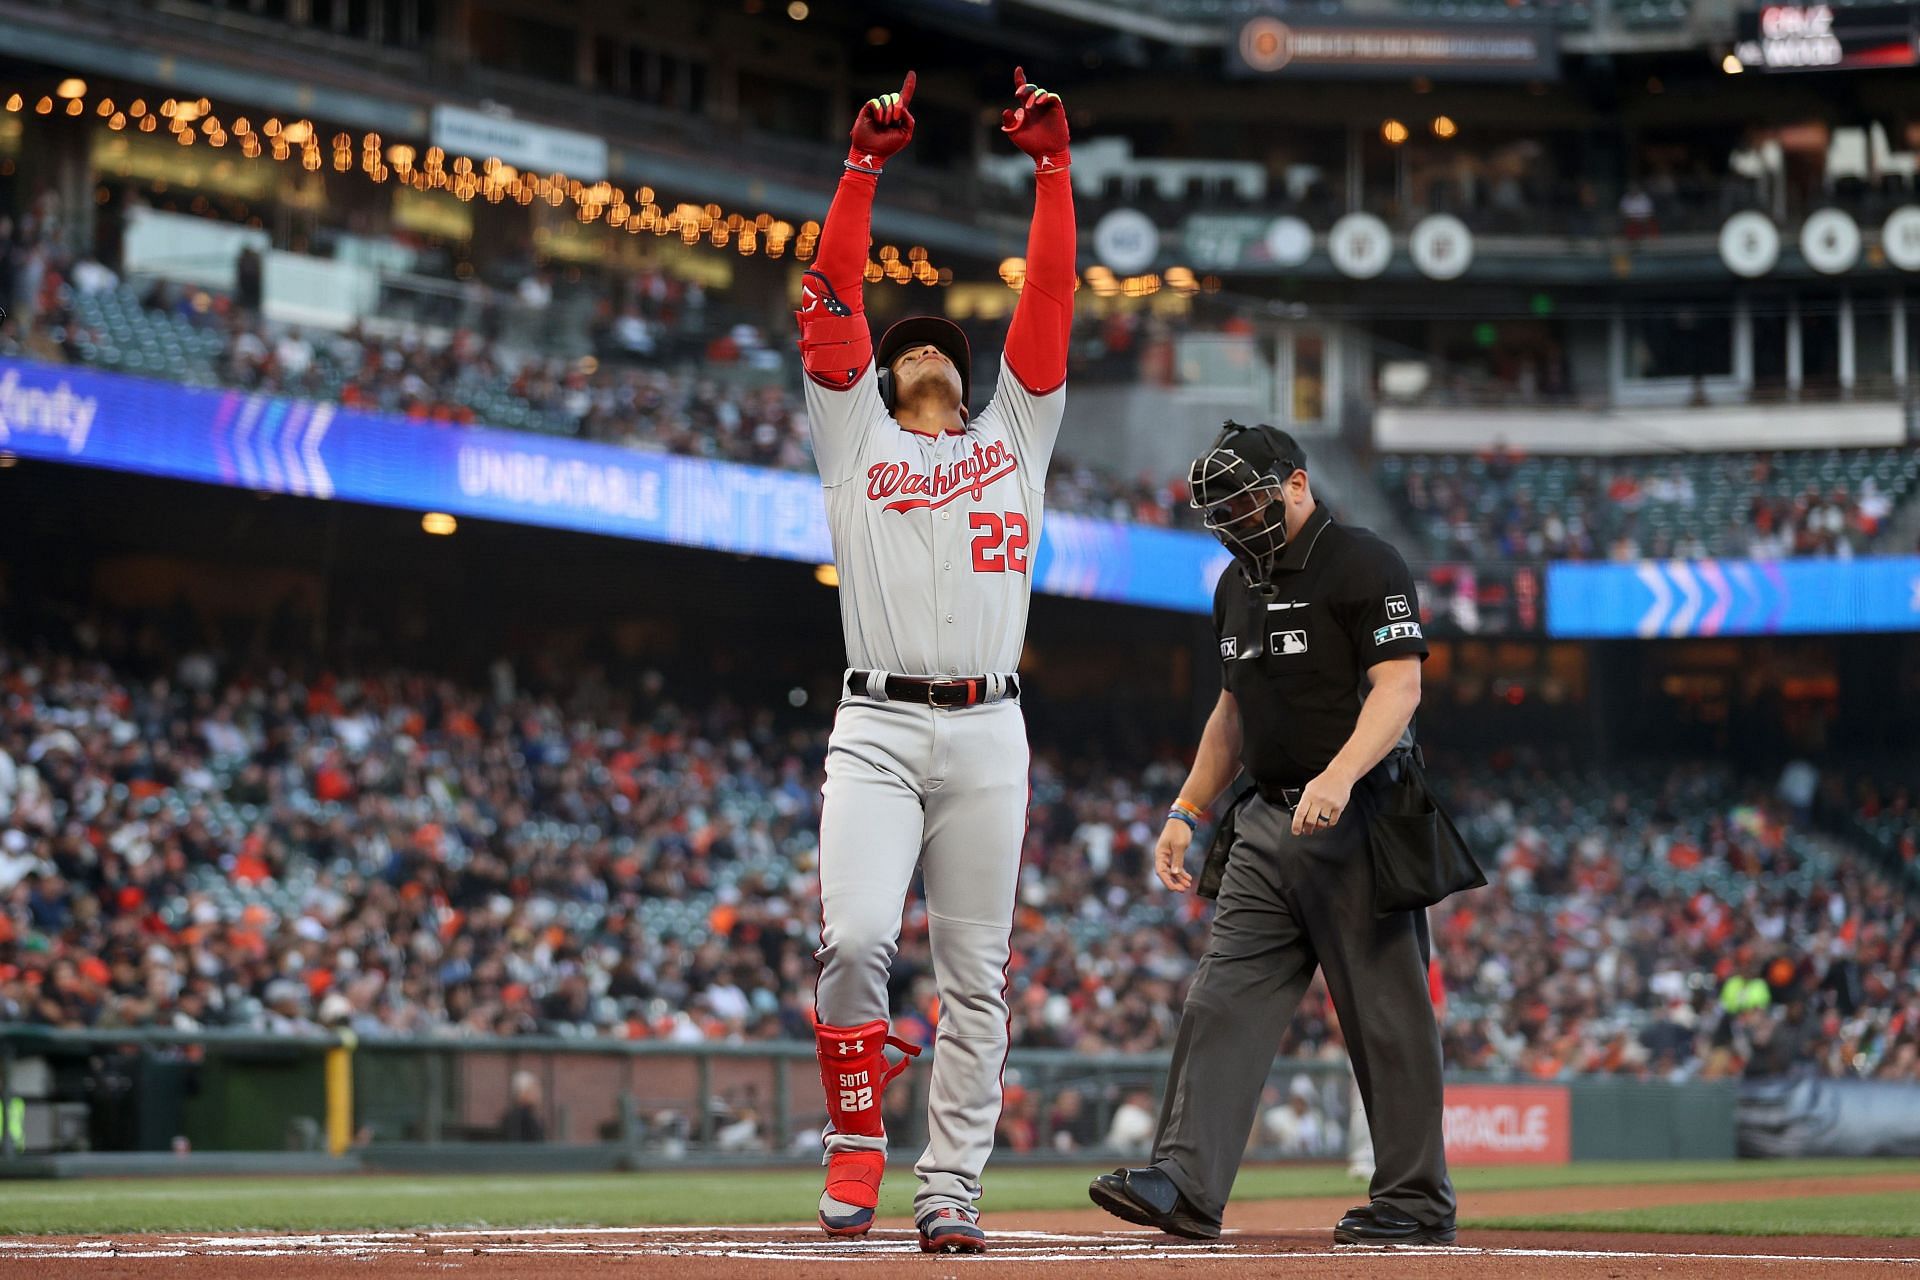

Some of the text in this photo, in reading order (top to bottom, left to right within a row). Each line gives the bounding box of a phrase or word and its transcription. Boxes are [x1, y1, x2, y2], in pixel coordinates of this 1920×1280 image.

[867, 439, 1018, 503] Washington
[968, 511, 1030, 576] 22
[1387, 600, 1407, 614] TC
[1390, 622, 1422, 638] FTX
[839, 1070, 869, 1087] SOTO
[839, 1086, 874, 1112] 22
